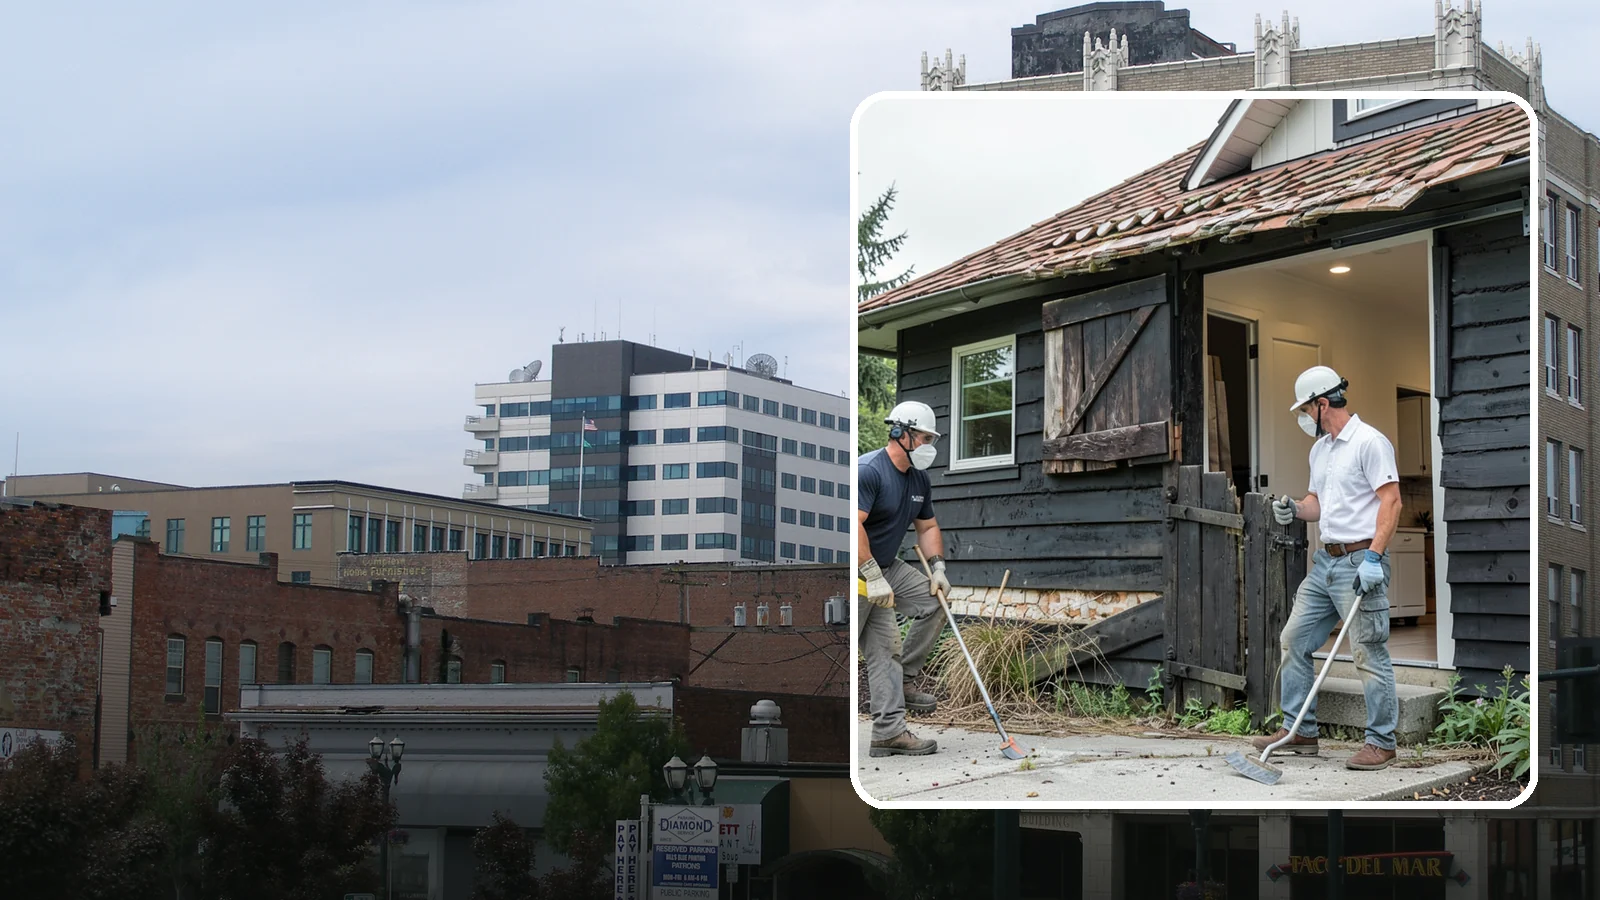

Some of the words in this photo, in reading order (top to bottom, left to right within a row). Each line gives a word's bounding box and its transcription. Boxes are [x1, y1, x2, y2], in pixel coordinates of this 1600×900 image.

[371, 567, 427, 577] Furnishers
[660, 818, 713, 833] DIAMOND
[1022, 816, 1069, 828] BUILDING
[617, 825, 625, 853] PAY
[628, 824, 637, 853] PAY
[656, 845, 688, 853] RESERVED
[689, 846, 716, 854] PARKING
[671, 861, 701, 870] PATRONS
[1289, 855, 1331, 874] TAC
[1346, 855, 1385, 876] DEL
[1391, 857, 1443, 877] MAR
[616, 856, 625, 894] HERE
[627, 855, 637, 894] HERE
[660, 888, 682, 897] PUBLIC
[683, 889, 710, 899] PARKING
